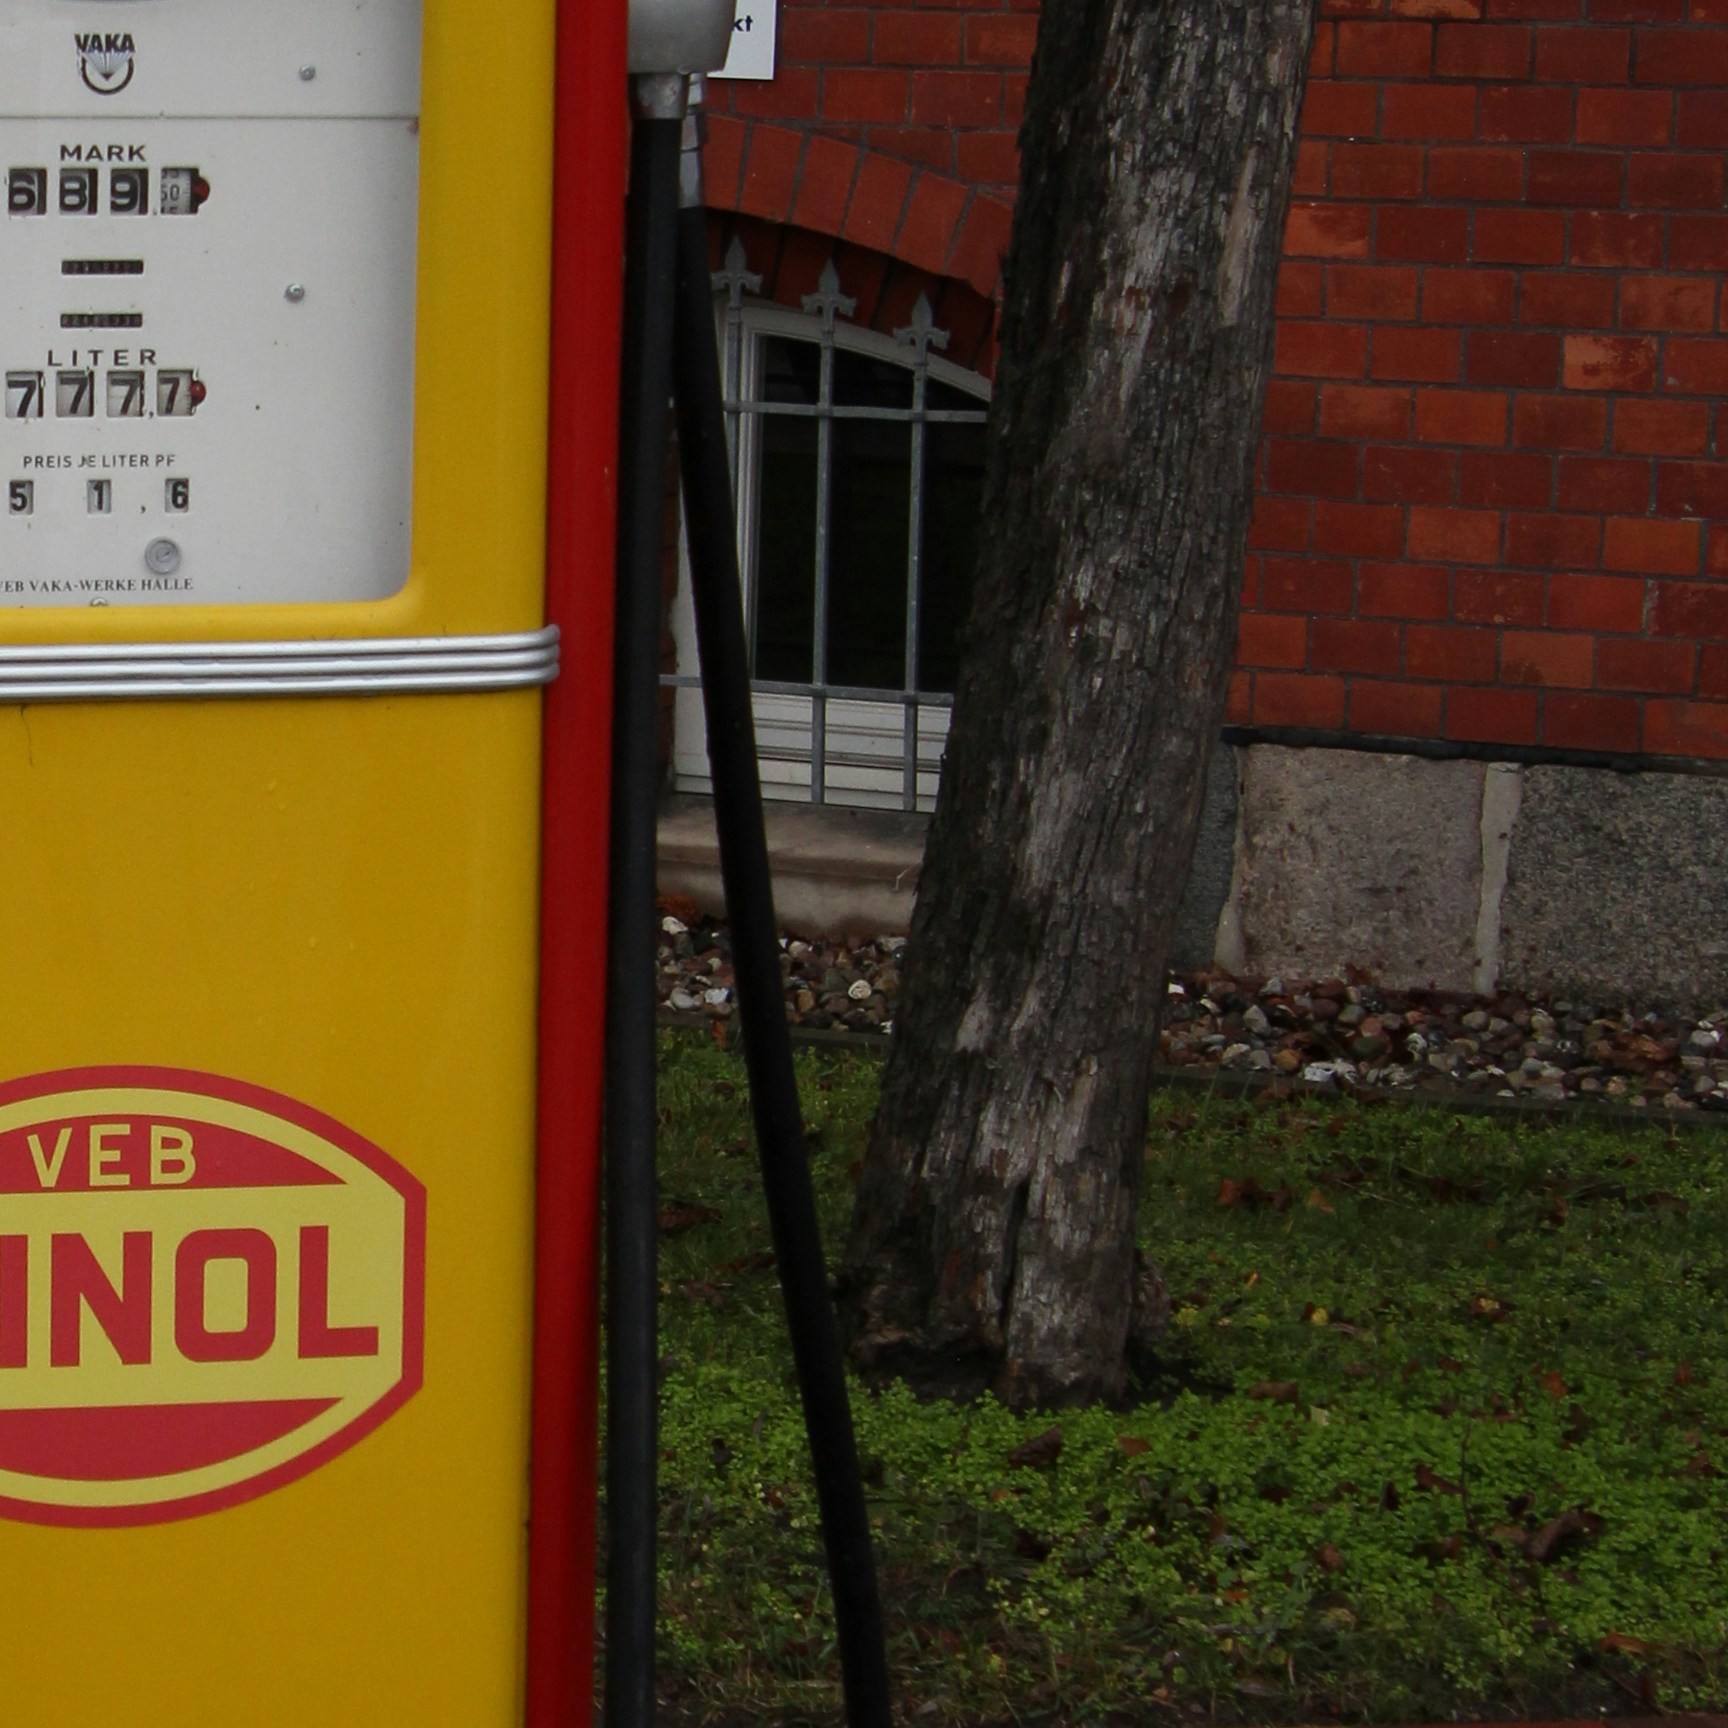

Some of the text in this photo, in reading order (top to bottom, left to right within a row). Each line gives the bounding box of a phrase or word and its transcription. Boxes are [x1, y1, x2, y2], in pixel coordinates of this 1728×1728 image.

[74, 33, 136, 53] VAKA
[60, 145, 147, 161] MARK
[47, 349, 157, 366] LITER
[23, 454, 176, 468] PREIS JE LITER PF
[29, 579, 137, 592] VAKA-WERKE
[141, 578, 194, 591] HALLE
[26, 1123, 197, 1189] VEB
